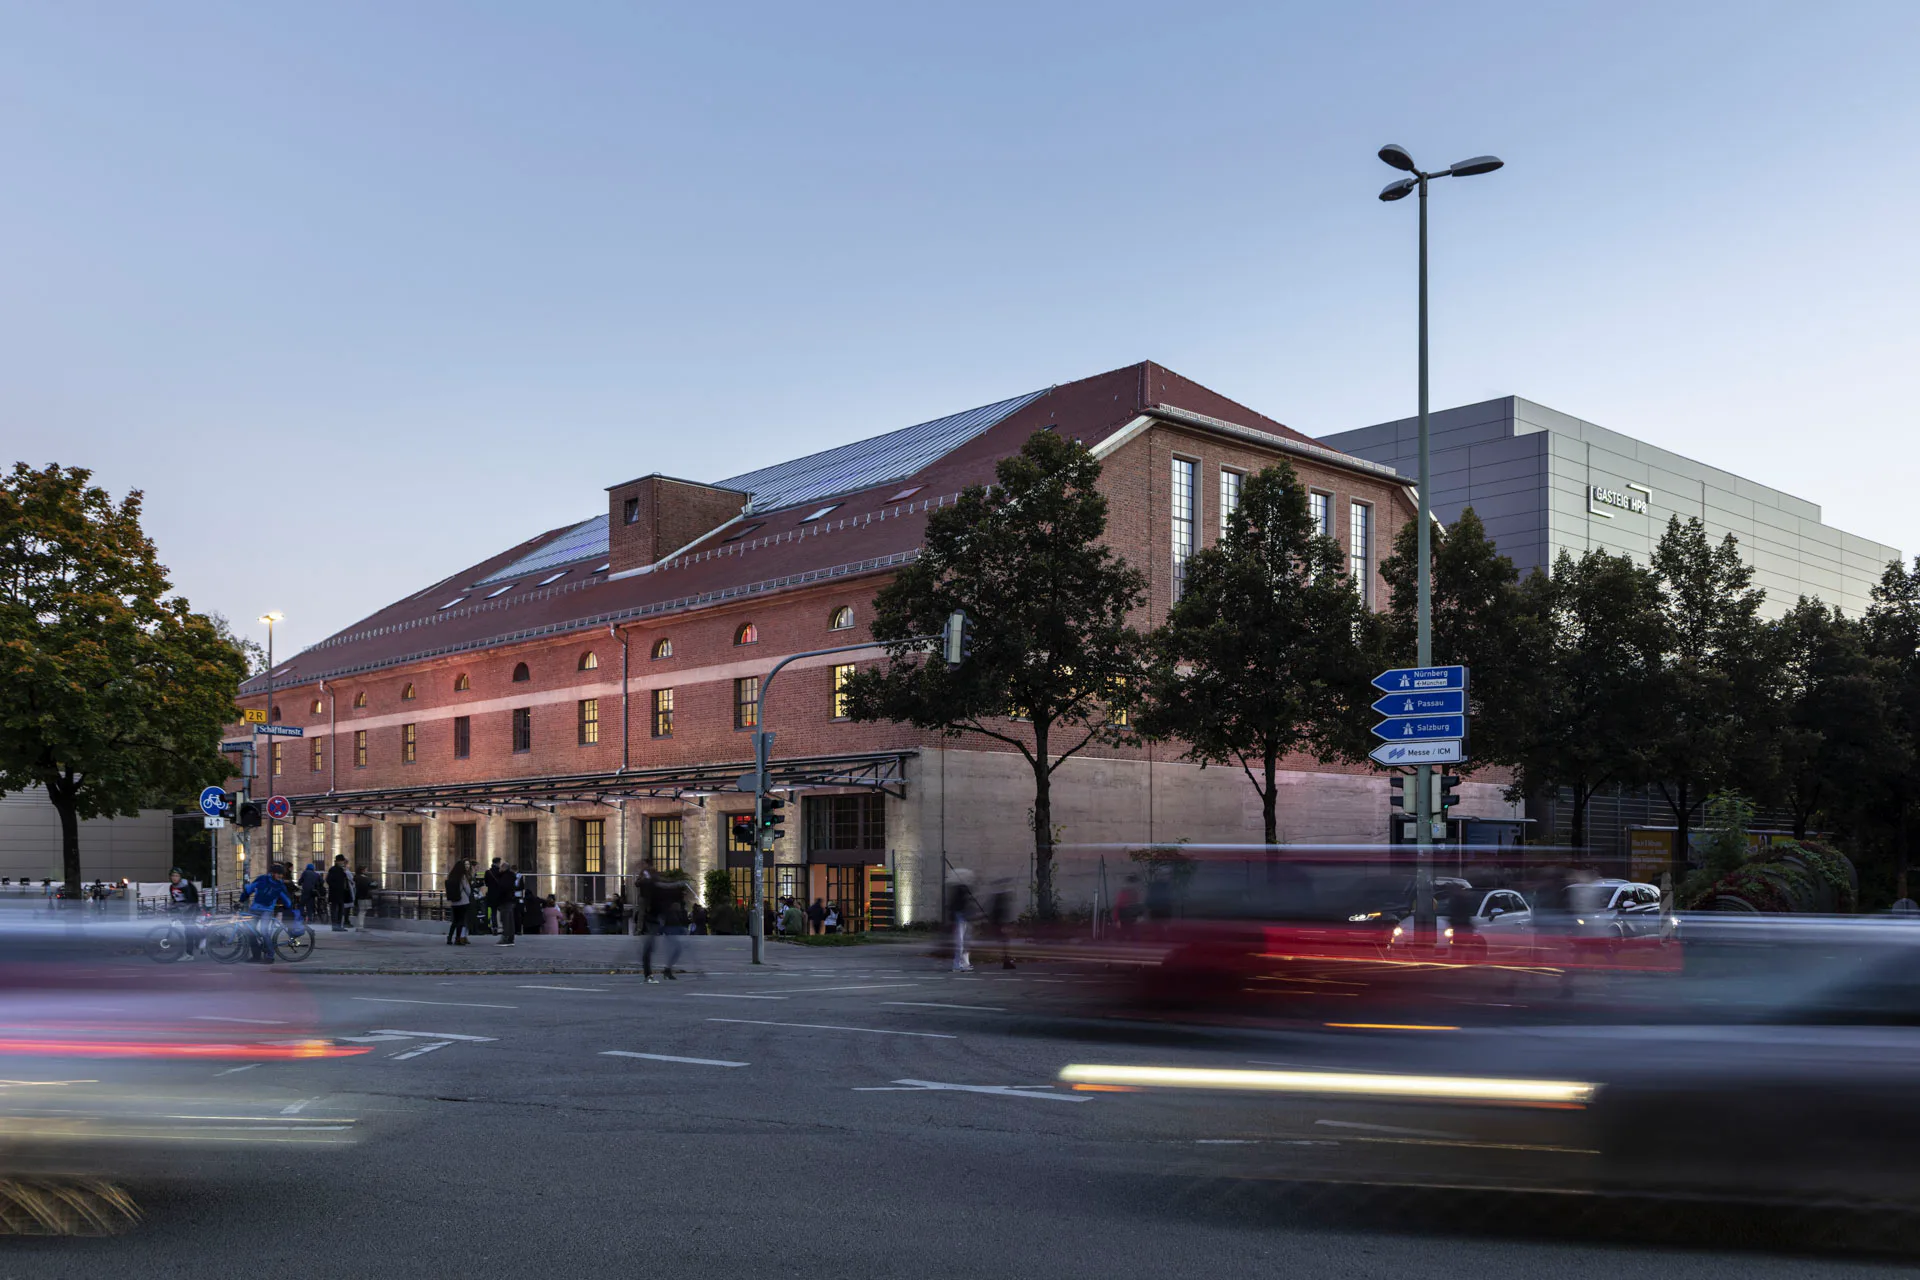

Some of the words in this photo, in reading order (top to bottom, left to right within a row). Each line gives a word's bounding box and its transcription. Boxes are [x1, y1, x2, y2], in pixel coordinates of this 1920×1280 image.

[1596, 487, 1629, 508] GASTEIG
[1631, 498, 1647, 514] HP8
[1414, 670, 1448, 678] Nürnberg
[249, 712, 254, 720] 2
[256, 711, 263, 720] R
[1417, 724, 1450, 733] Salzburg
